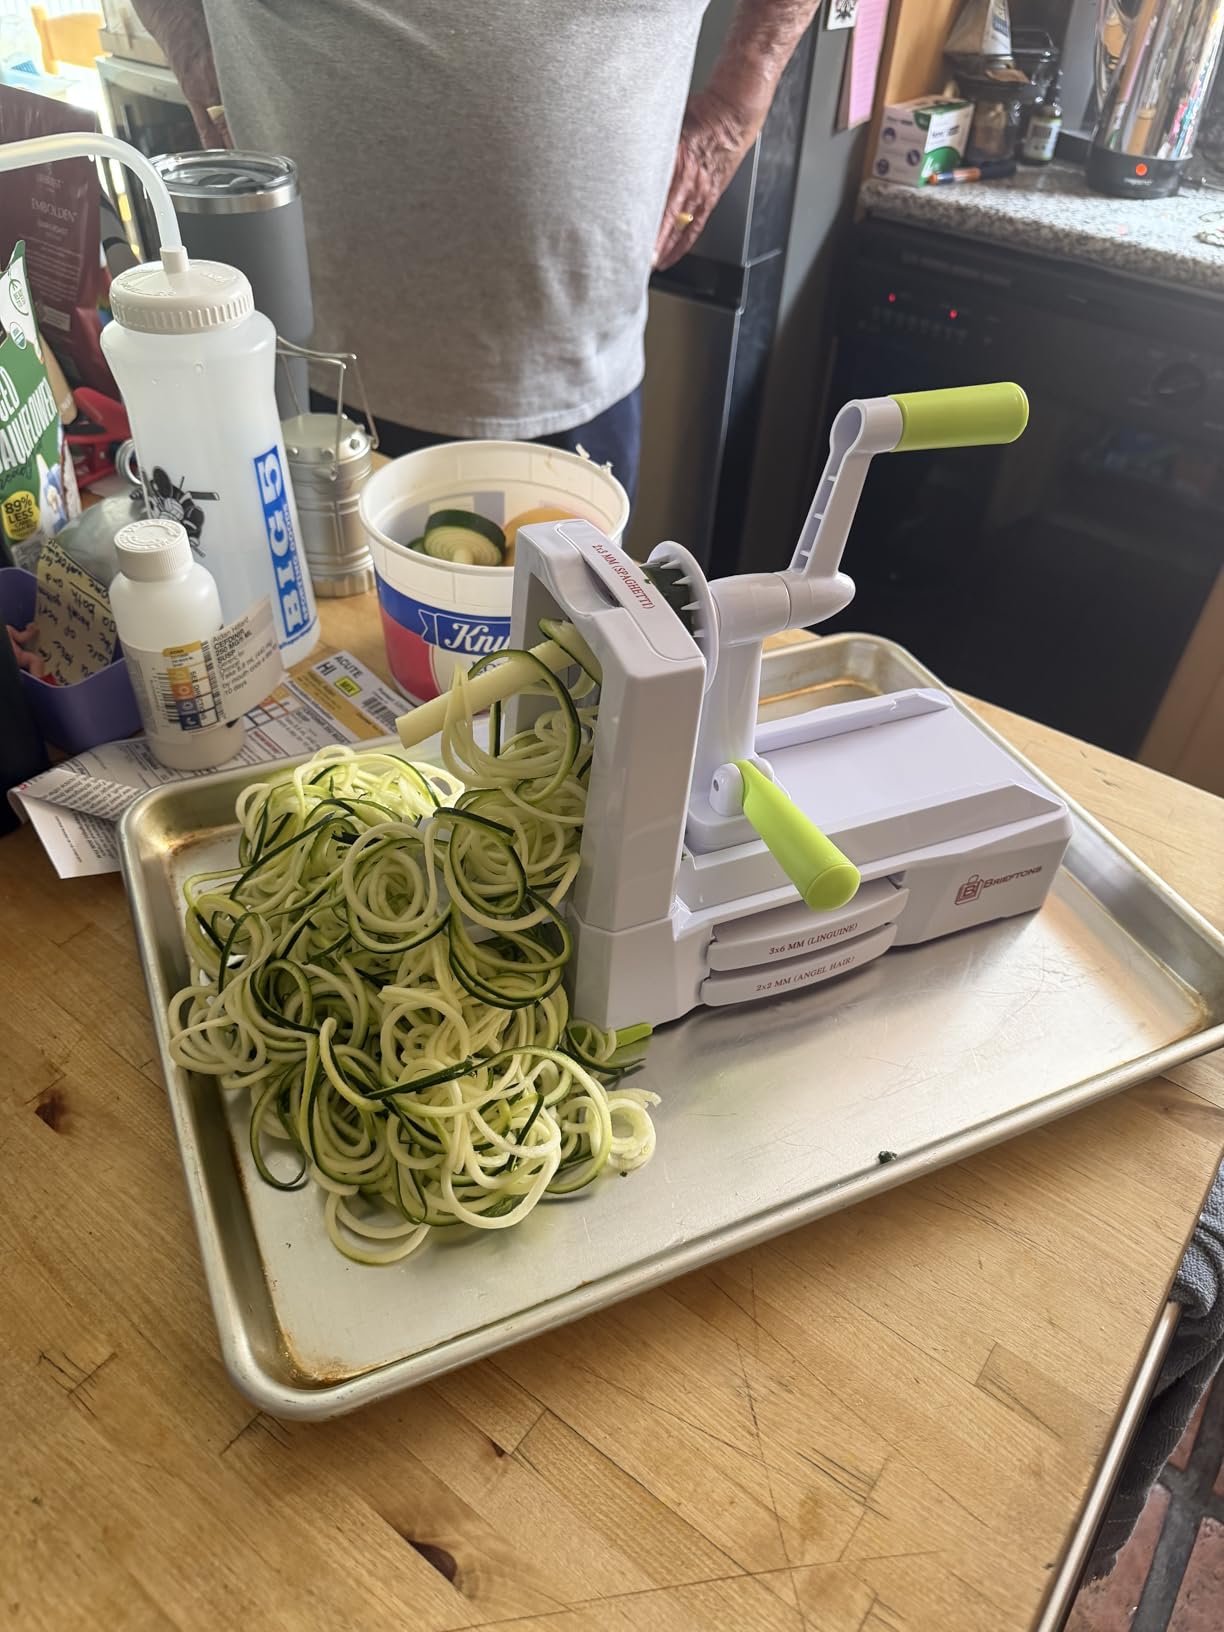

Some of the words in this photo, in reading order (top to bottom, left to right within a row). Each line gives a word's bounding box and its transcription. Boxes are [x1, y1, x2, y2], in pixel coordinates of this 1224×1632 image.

[0, 377, 57, 474] AULIFLOWER
[258, 453, 282, 505] 5
[5, 494, 32, 514] 89%
[8, 507, 33, 524] LESS
[268, 508, 304, 633] BIG
[601, 553, 619, 565] MM
[612, 563, 655, 609] (SPAGHETTI)
[315, 661, 337, 676] HI
[335, 656, 363, 678] ACUTE
[983, 866, 1042, 888] BRIEFTONS
[768, 945, 786, 955] 3x6
[787, 940, 805, 950] MM
[807, 923, 858, 946] (LINGUINE)
[756, 981, 772, 992] 2x2
[774, 976, 791, 987] MM
[793, 965, 827, 984] (ANGEL
[829, 956, 856, 972] HAIR)
